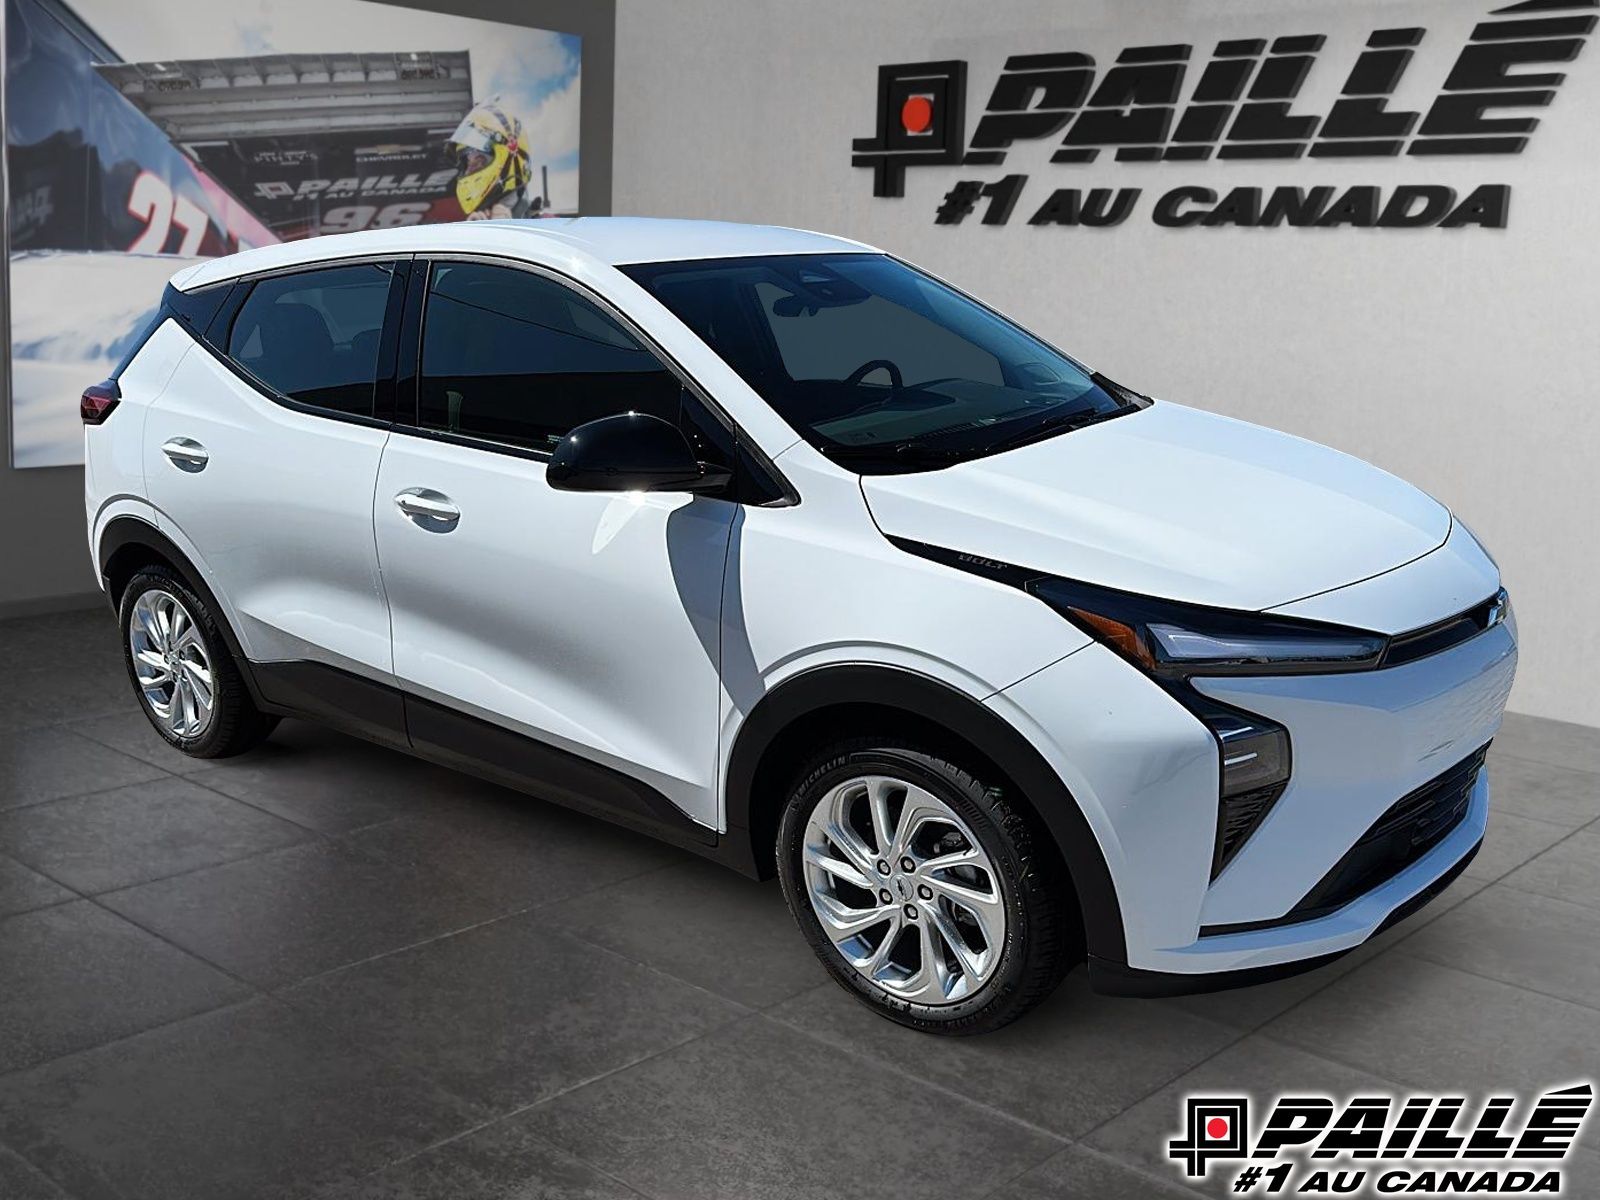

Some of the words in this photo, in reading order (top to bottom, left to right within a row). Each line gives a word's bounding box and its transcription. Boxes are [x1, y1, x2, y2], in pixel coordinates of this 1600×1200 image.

[963, 0, 1600, 166] PAILLÉ
[356, 153, 428, 163] CHEVROLET
[324, 191, 354, 200] AU
[361, 186, 447, 197] CANADA
[934, 174, 1029, 226] #1
[1027, 188, 1143, 227] AU
[1151, 184, 1511, 229] CANADA
[320, 202, 431, 234] 96
